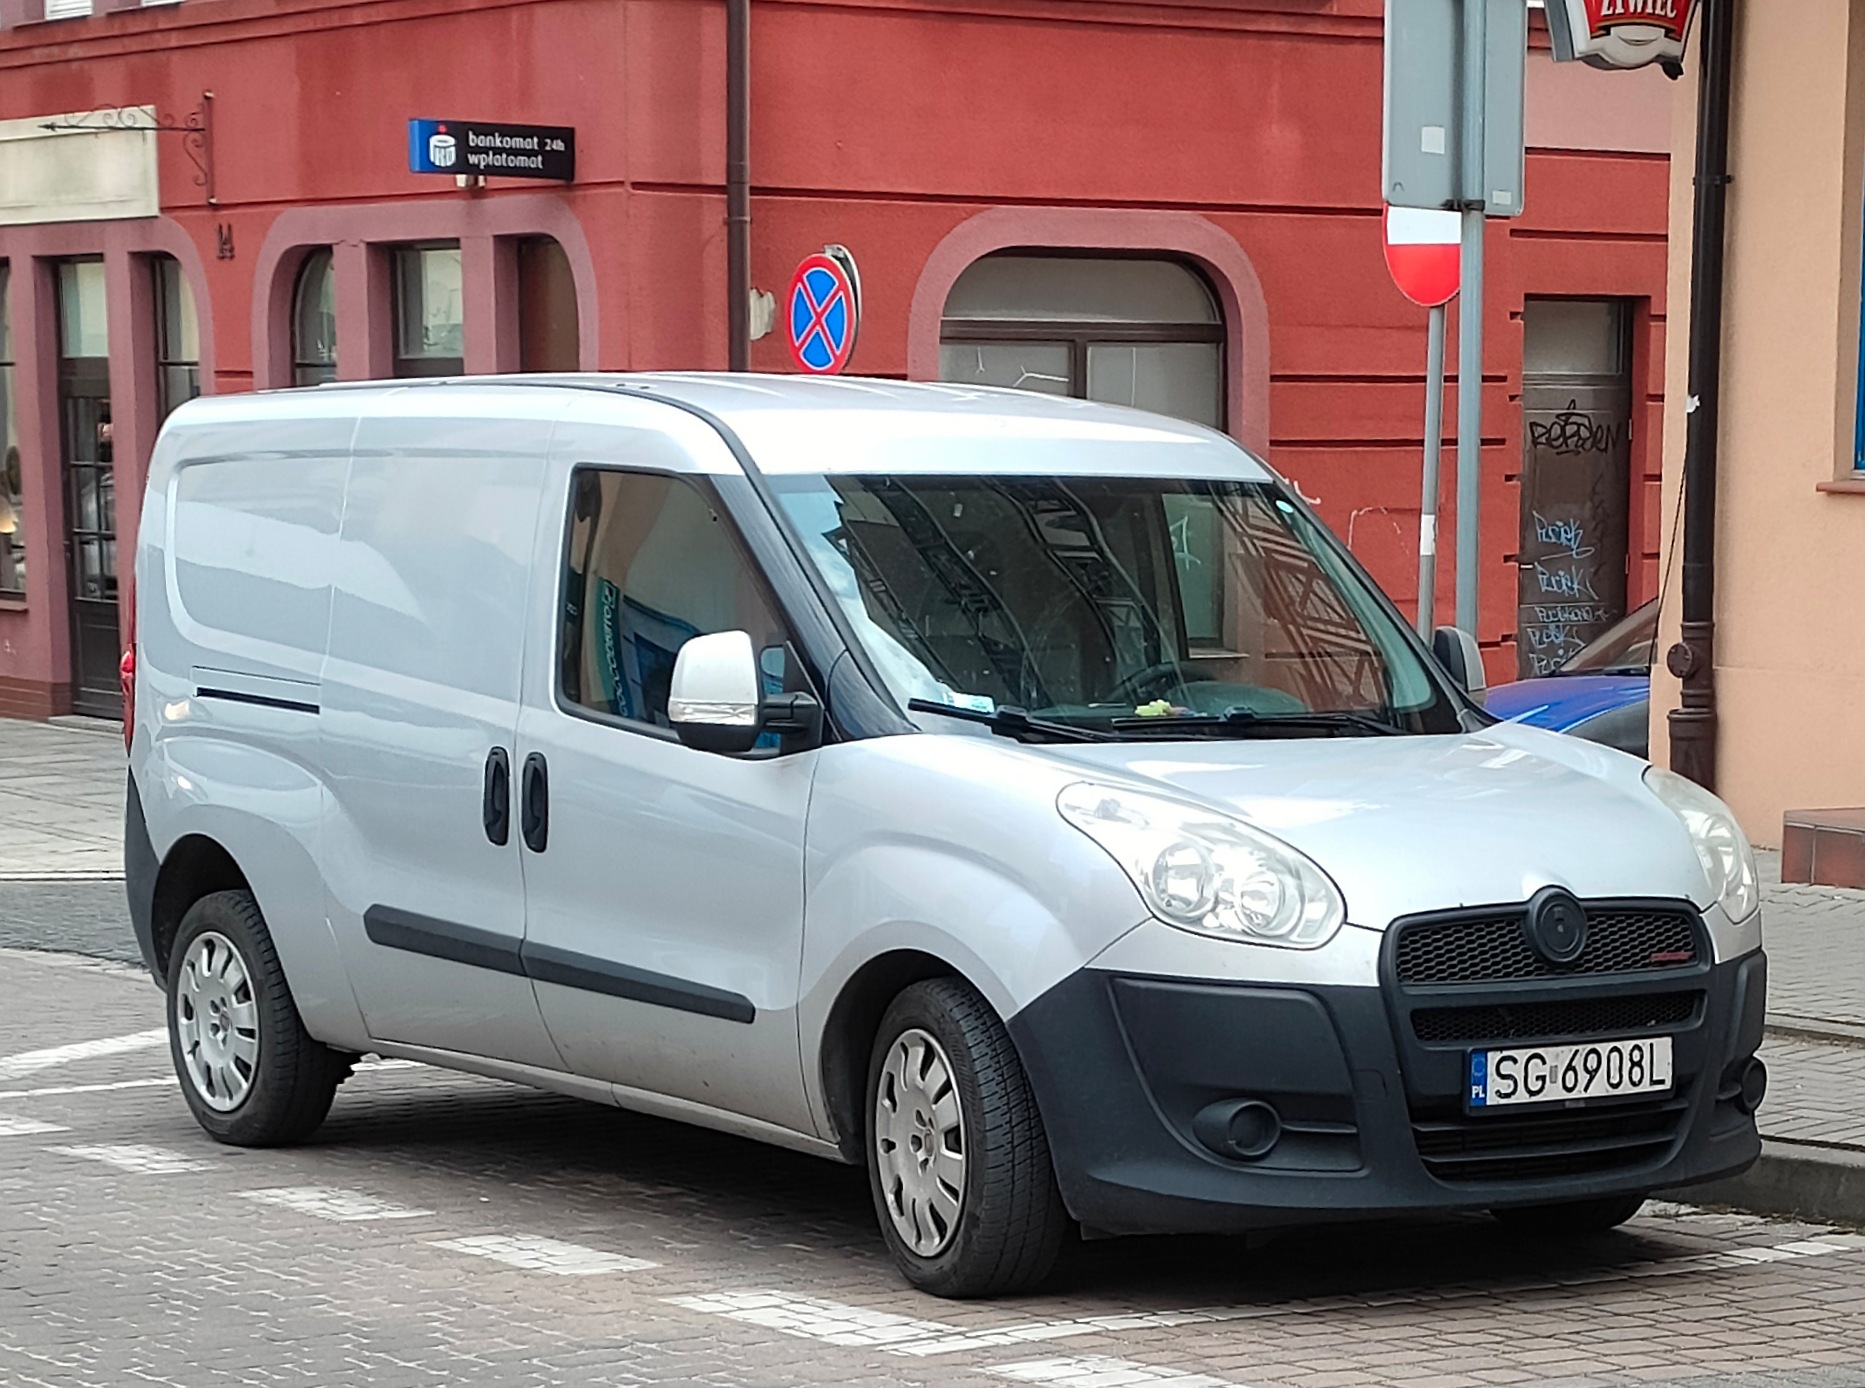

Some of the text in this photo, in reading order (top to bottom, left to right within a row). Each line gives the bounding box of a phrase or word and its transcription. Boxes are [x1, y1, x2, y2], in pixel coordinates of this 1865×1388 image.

[468, 130, 565, 151] bankomat 24h
[467, 150, 543, 170] wpłatomat
[1494, 1042, 1666, 1099] SG 6908L
[1471, 1085, 1485, 1099] PL
